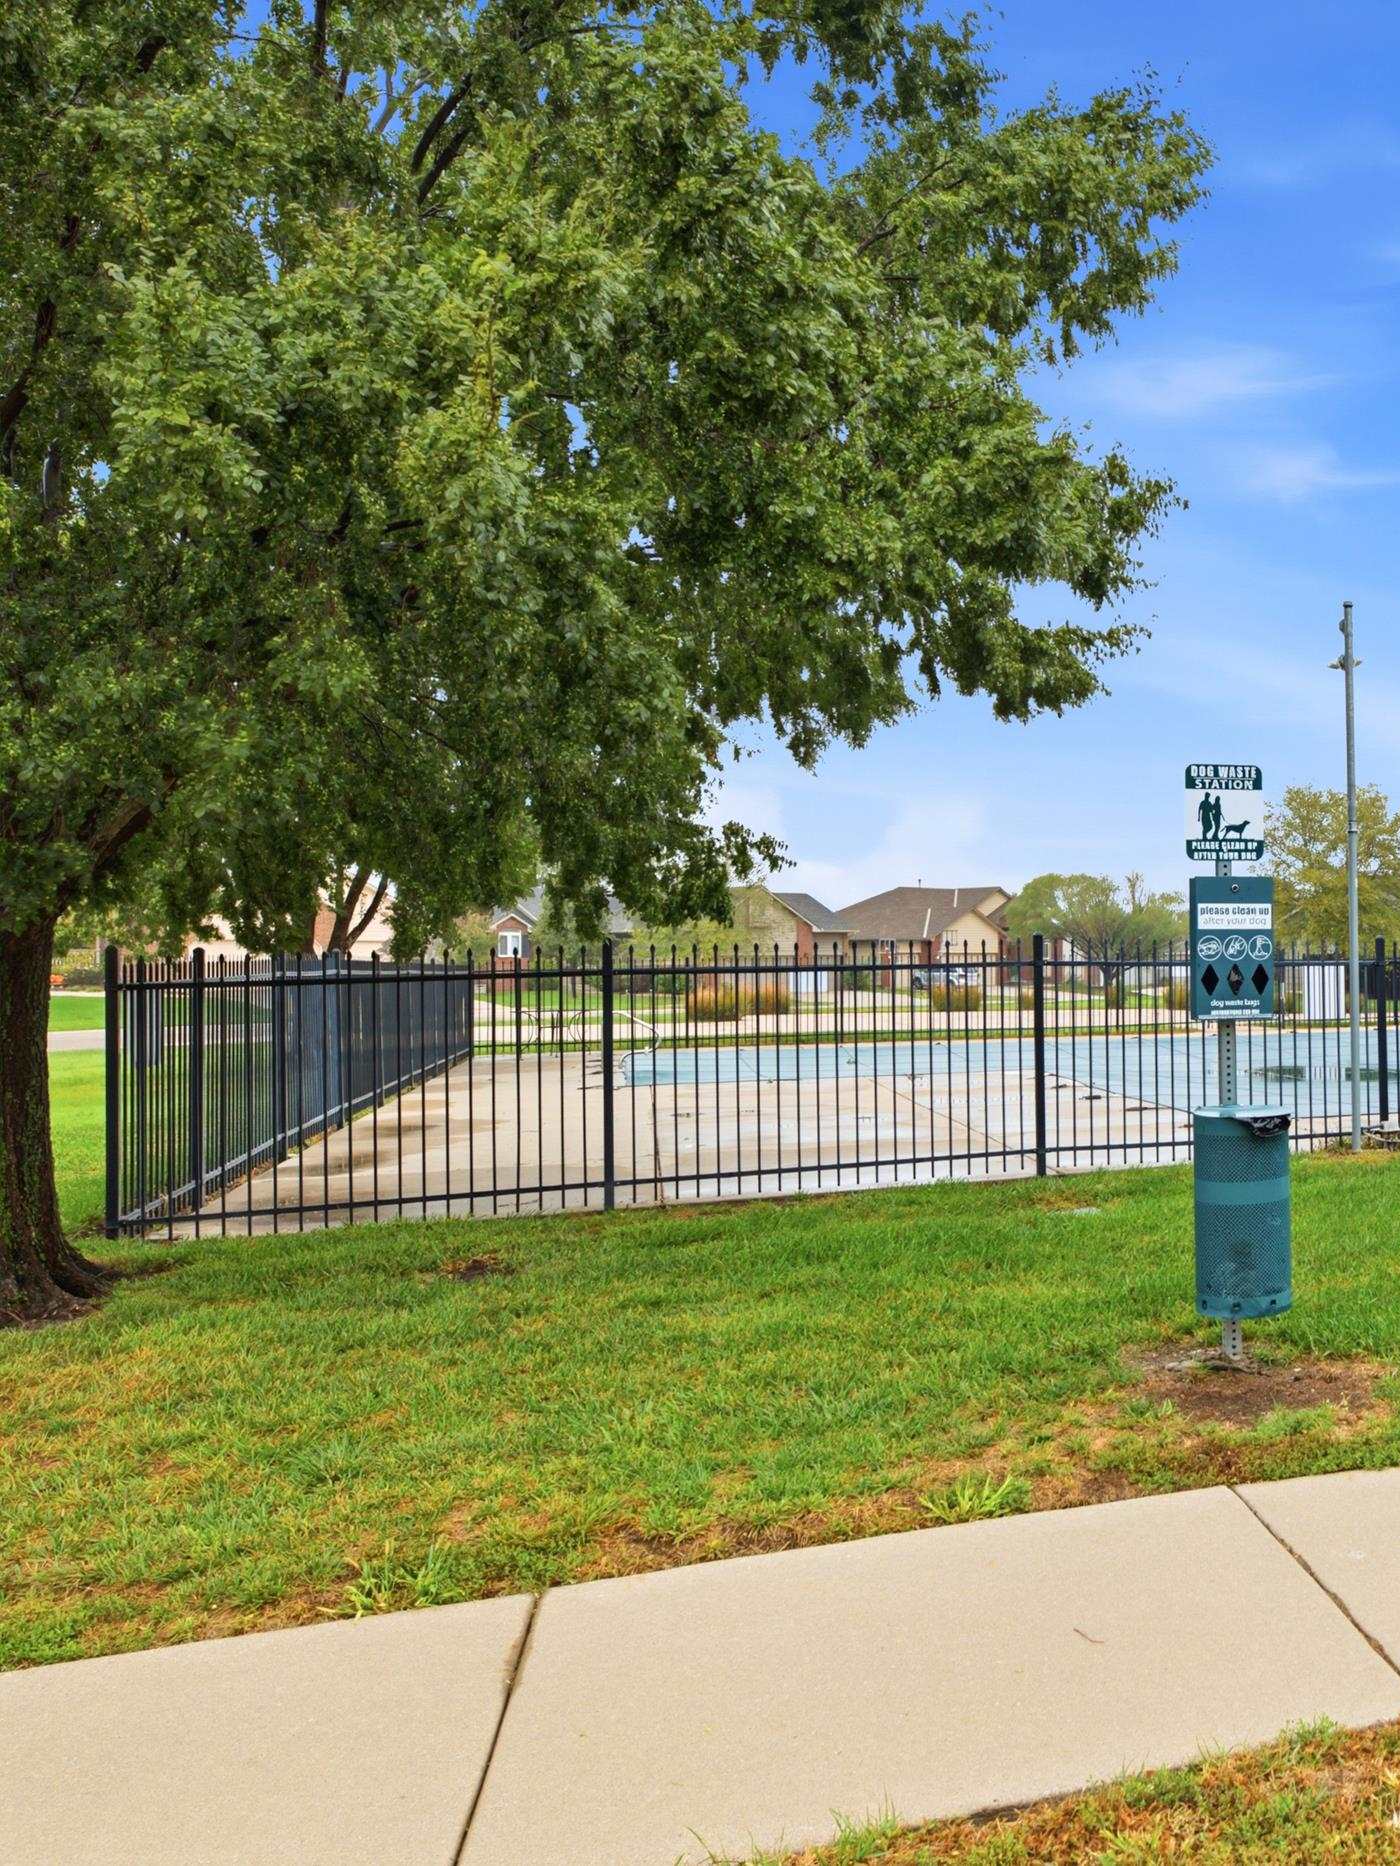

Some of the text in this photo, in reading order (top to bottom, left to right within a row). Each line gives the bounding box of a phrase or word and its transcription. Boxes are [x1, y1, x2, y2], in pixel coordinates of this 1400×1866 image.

[1191, 765, 1257, 779] DOG WASTE
[1195, 778, 1253, 790] STATION
[1192, 841, 1258, 850] PLEASE CLEAN UP
[1200, 906, 1269, 916] please clean up
[1203, 917, 1267, 926] after your dog
[1210, 999, 1225, 1007] dog
